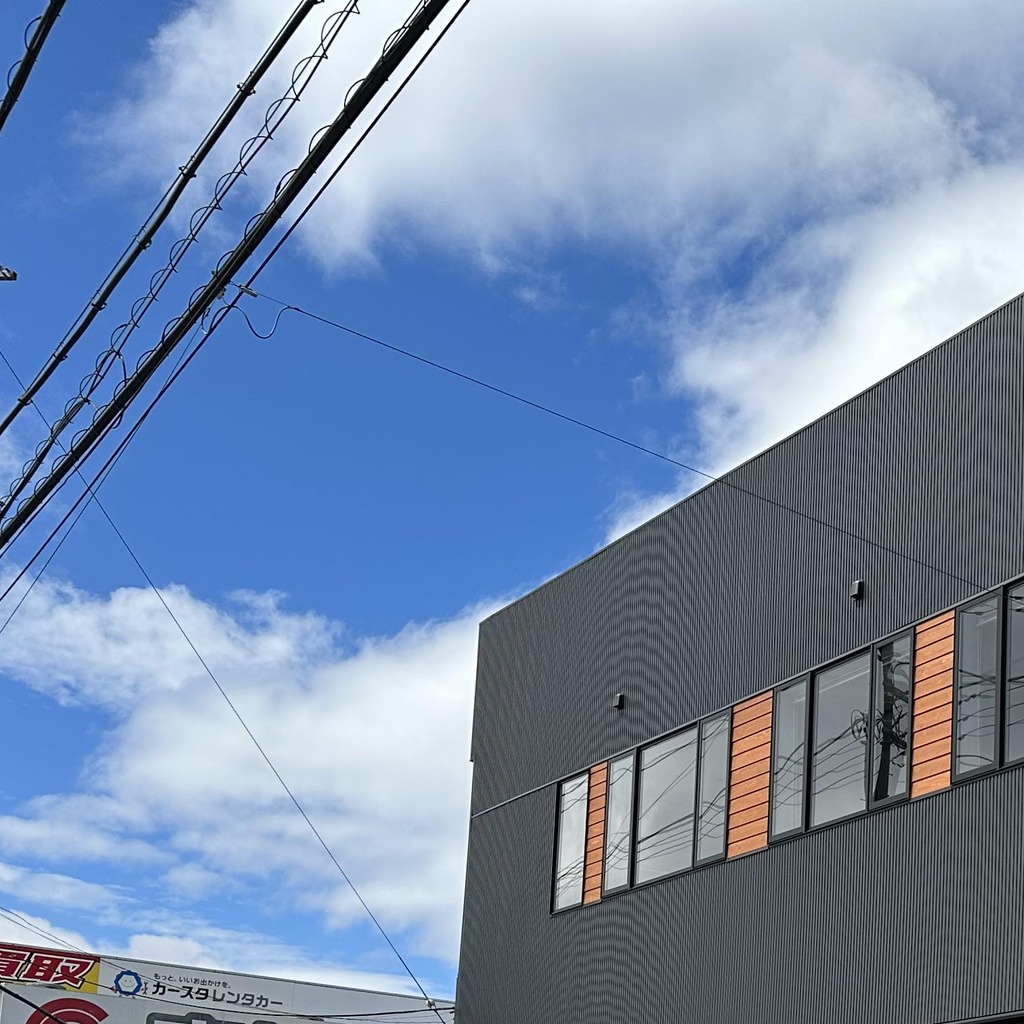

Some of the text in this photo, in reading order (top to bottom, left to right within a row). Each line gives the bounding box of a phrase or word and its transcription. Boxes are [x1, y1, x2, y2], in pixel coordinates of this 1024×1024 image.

[151, 981, 284, 1009] カースタレンタカー
